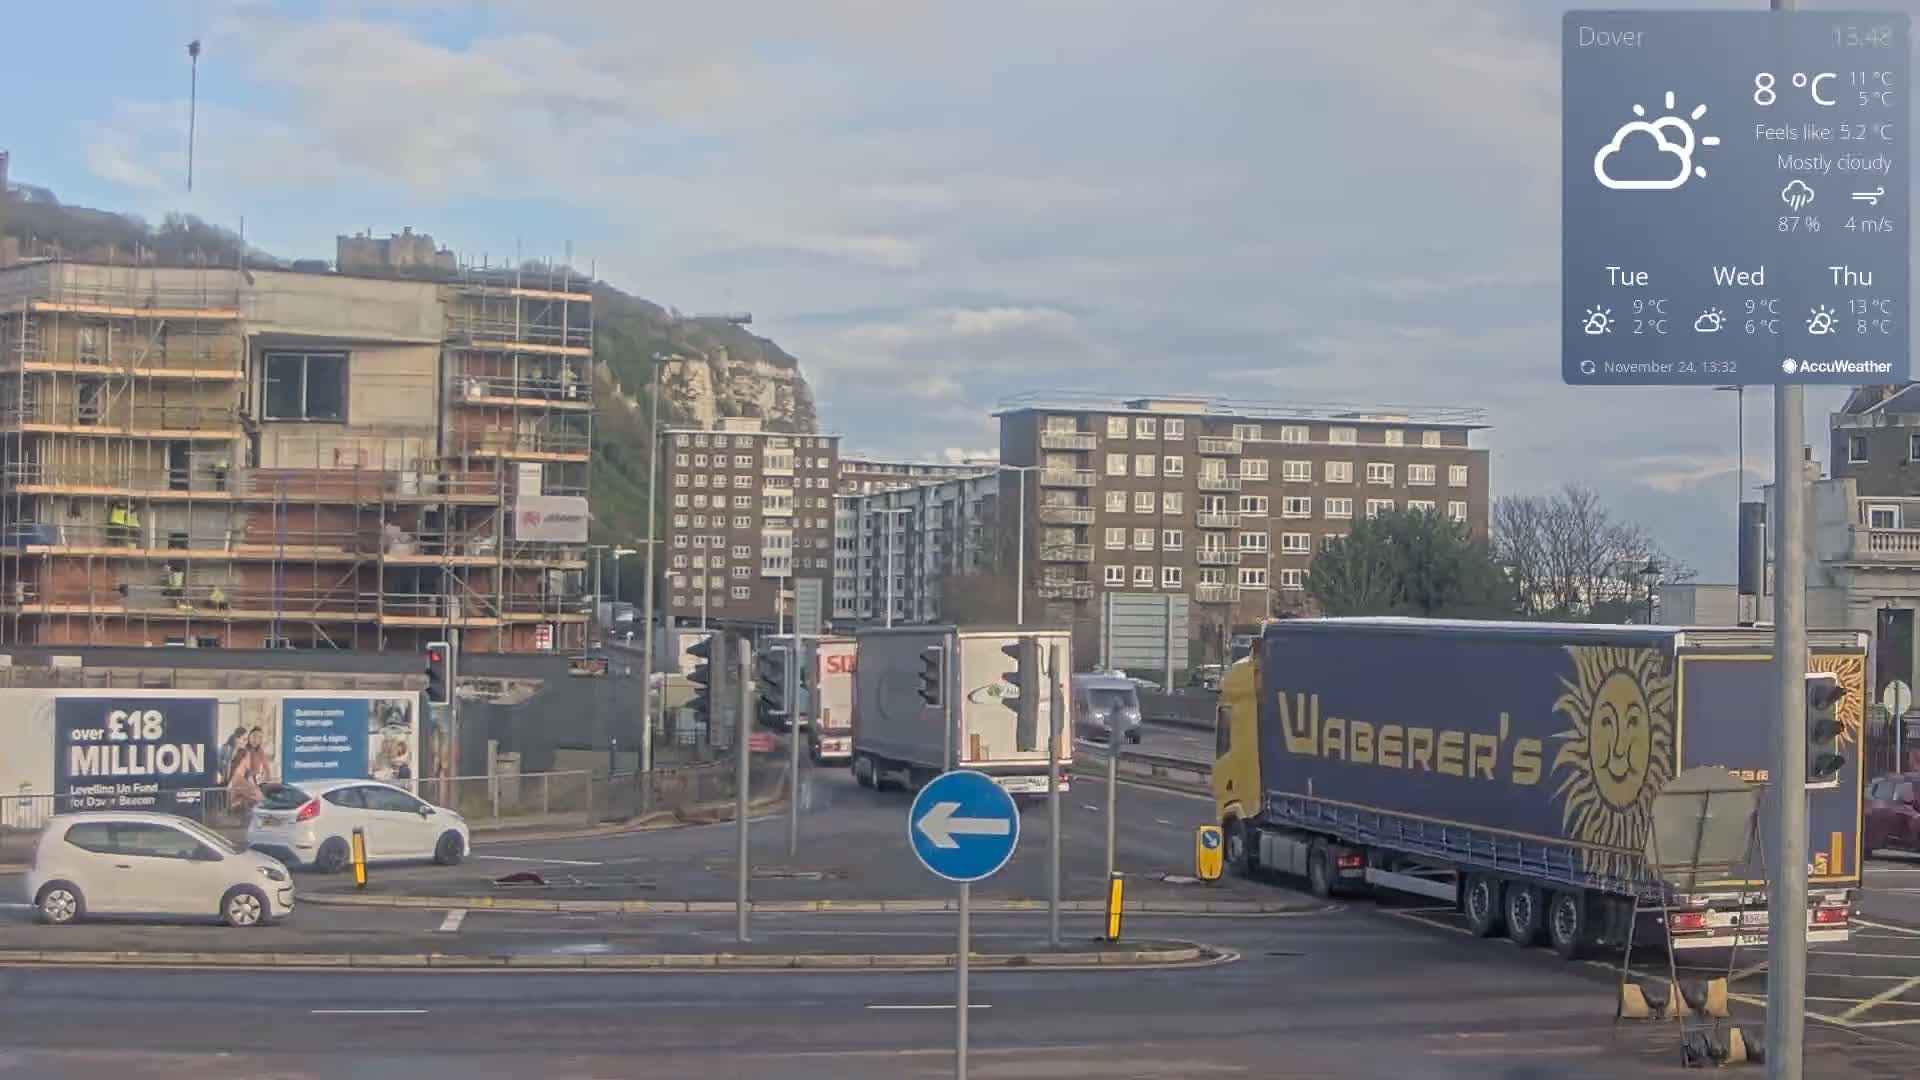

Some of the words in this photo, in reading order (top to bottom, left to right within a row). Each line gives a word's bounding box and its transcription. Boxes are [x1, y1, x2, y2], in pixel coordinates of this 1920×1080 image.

[71, 728, 104, 740] over
[108, 710, 163, 740] £18
[70, 744, 205, 776] MILLION
